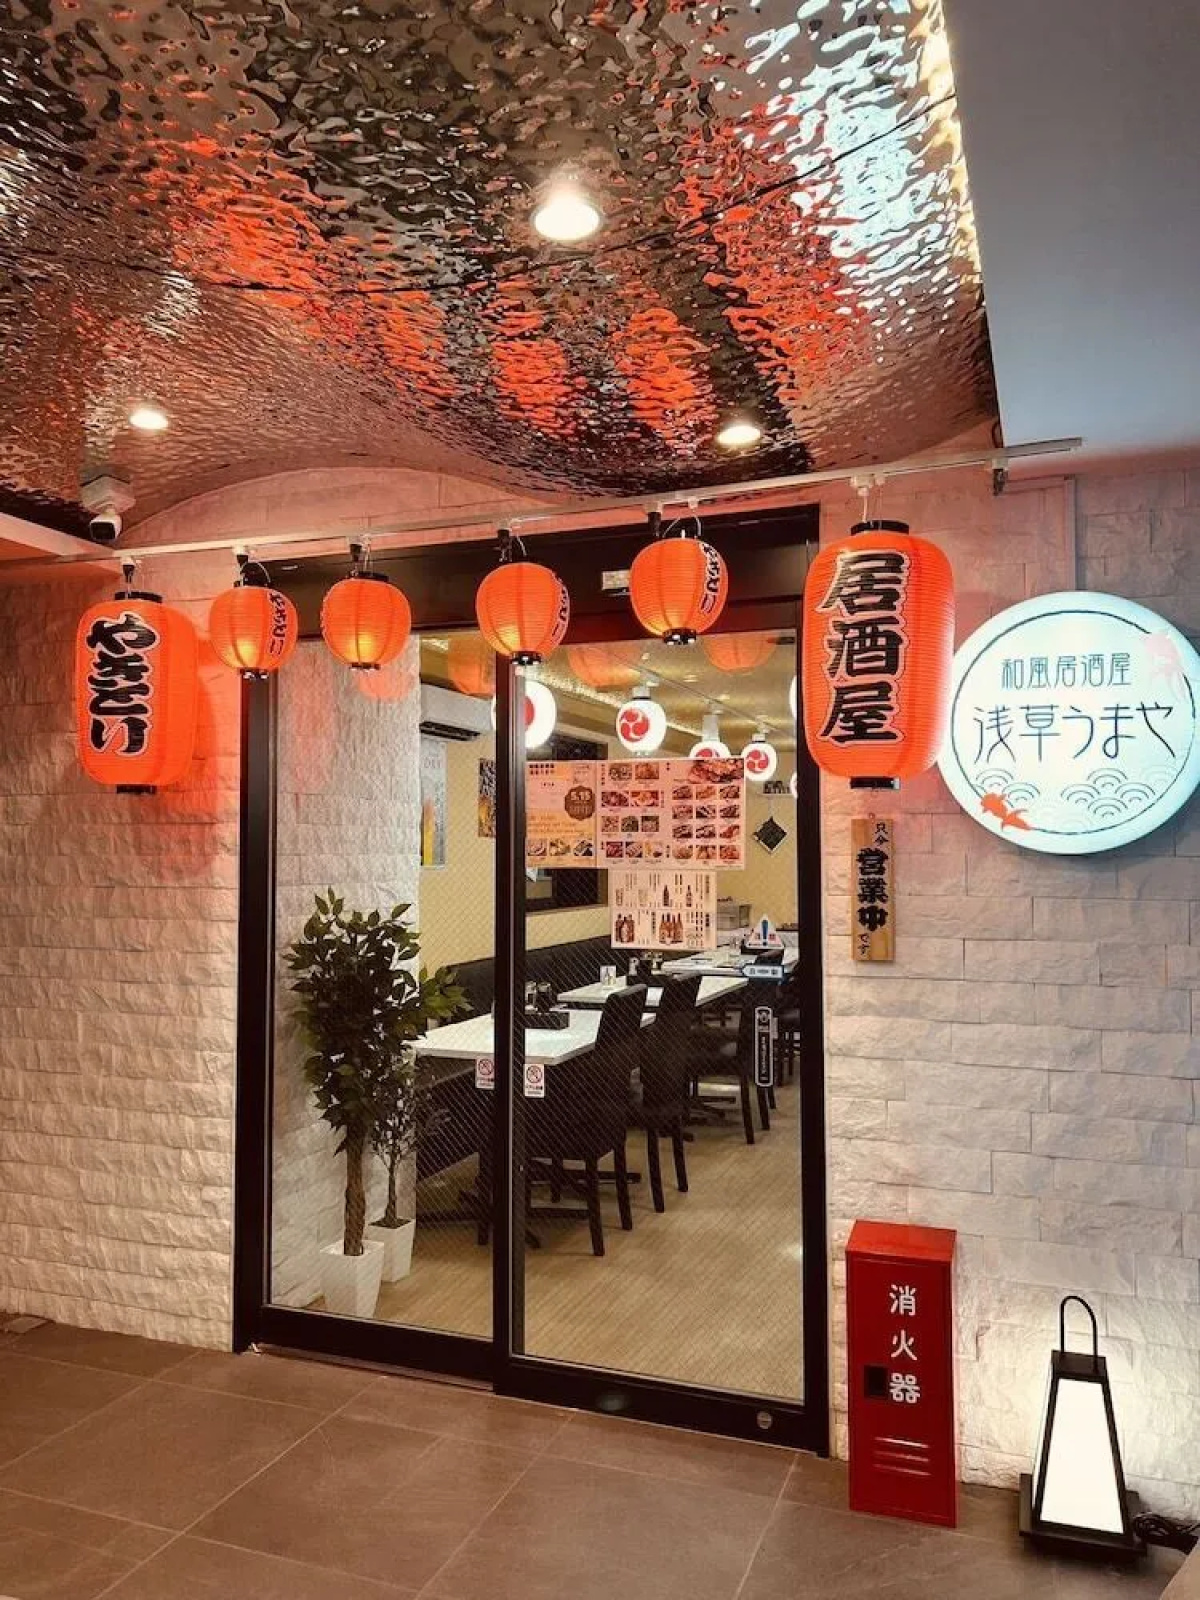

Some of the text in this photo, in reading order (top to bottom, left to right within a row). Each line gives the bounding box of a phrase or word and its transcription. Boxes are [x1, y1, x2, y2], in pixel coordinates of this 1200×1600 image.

[86, 612, 158, 755] やきとり
[819, 551, 907, 745] 居酒屋
[1001, 653, 1131, 689] 和風居酒屋
[973, 701, 1176, 764] 浅草うまや
[874, 822, 889, 846] 只今
[856, 847, 889, 932] 営業中
[889, 1284, 921, 1404] 消火器
